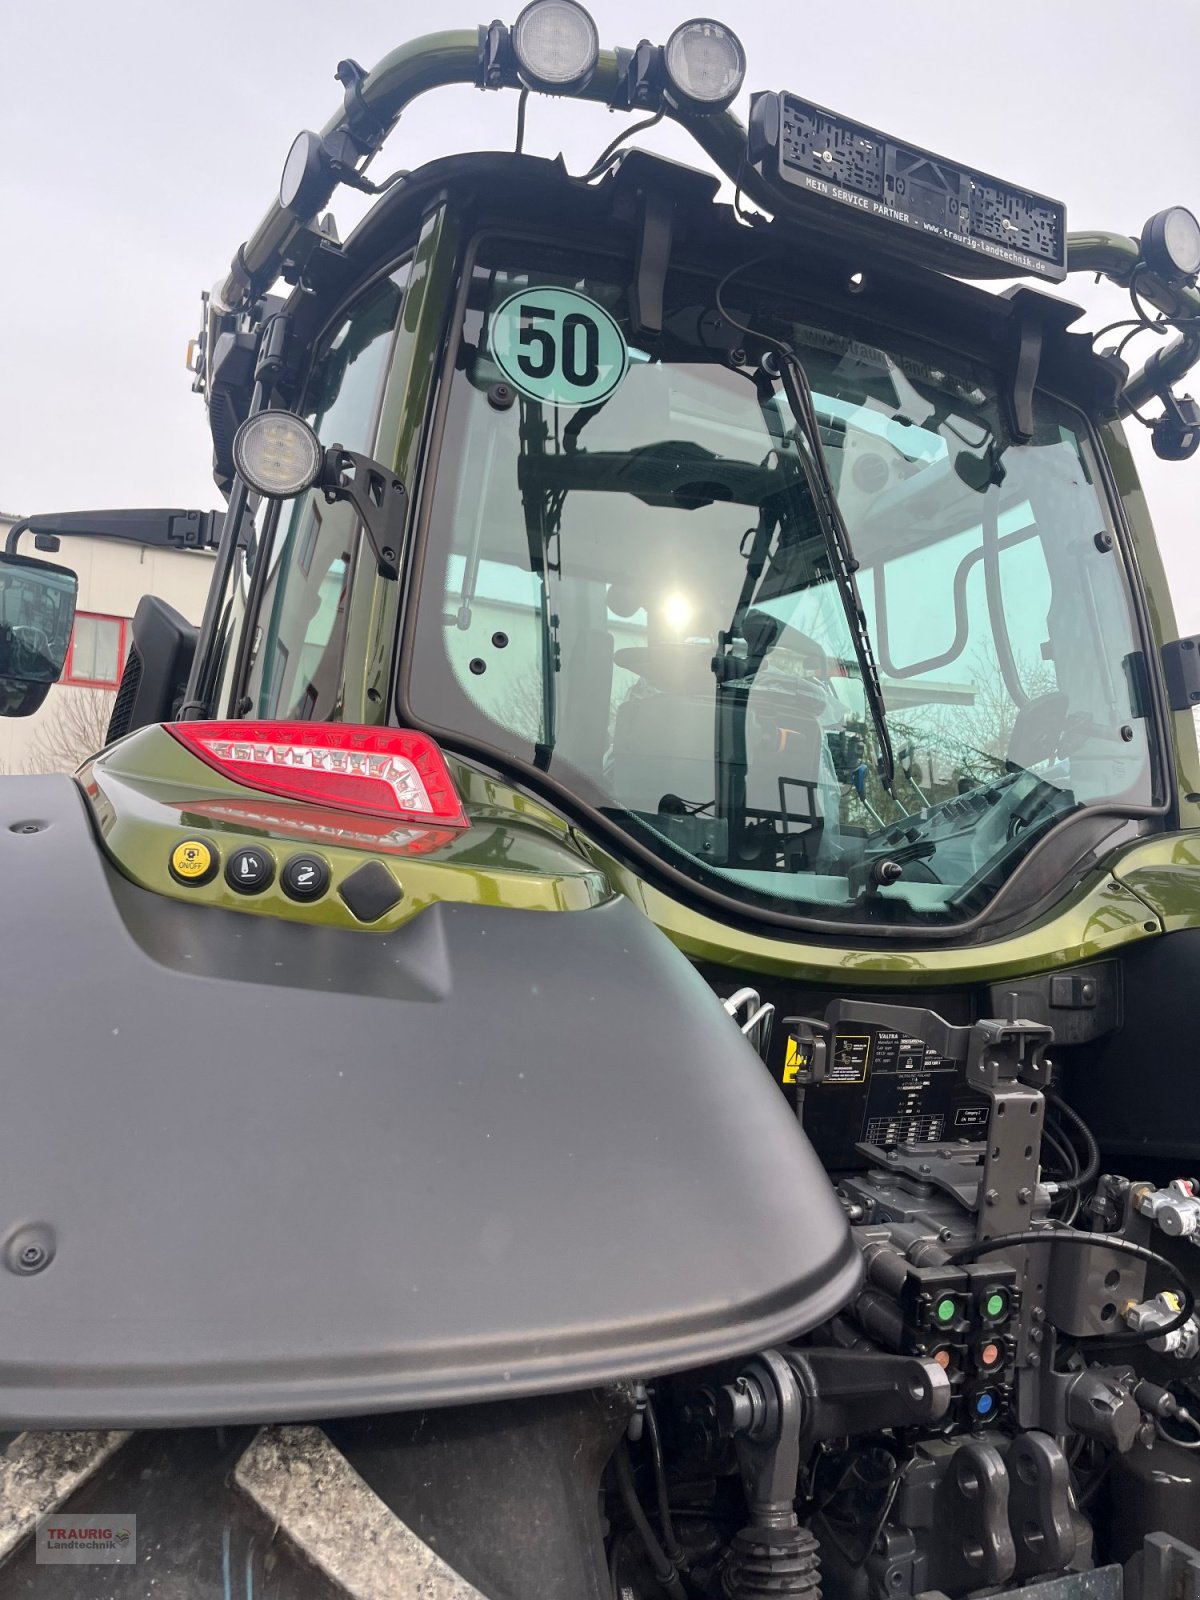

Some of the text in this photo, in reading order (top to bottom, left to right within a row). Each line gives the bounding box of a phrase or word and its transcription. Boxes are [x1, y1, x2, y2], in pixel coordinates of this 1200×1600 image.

[806, 177, 828, 193] MEIN
[832, 188, 869, 209] SERVICE
[873, 202, 910, 223] PARTNER
[923, 222, 1046, 271] www.traurig-landtechnik.de
[517, 304, 599, 387] 50
[178, 861, 202, 870] ON/OFF
